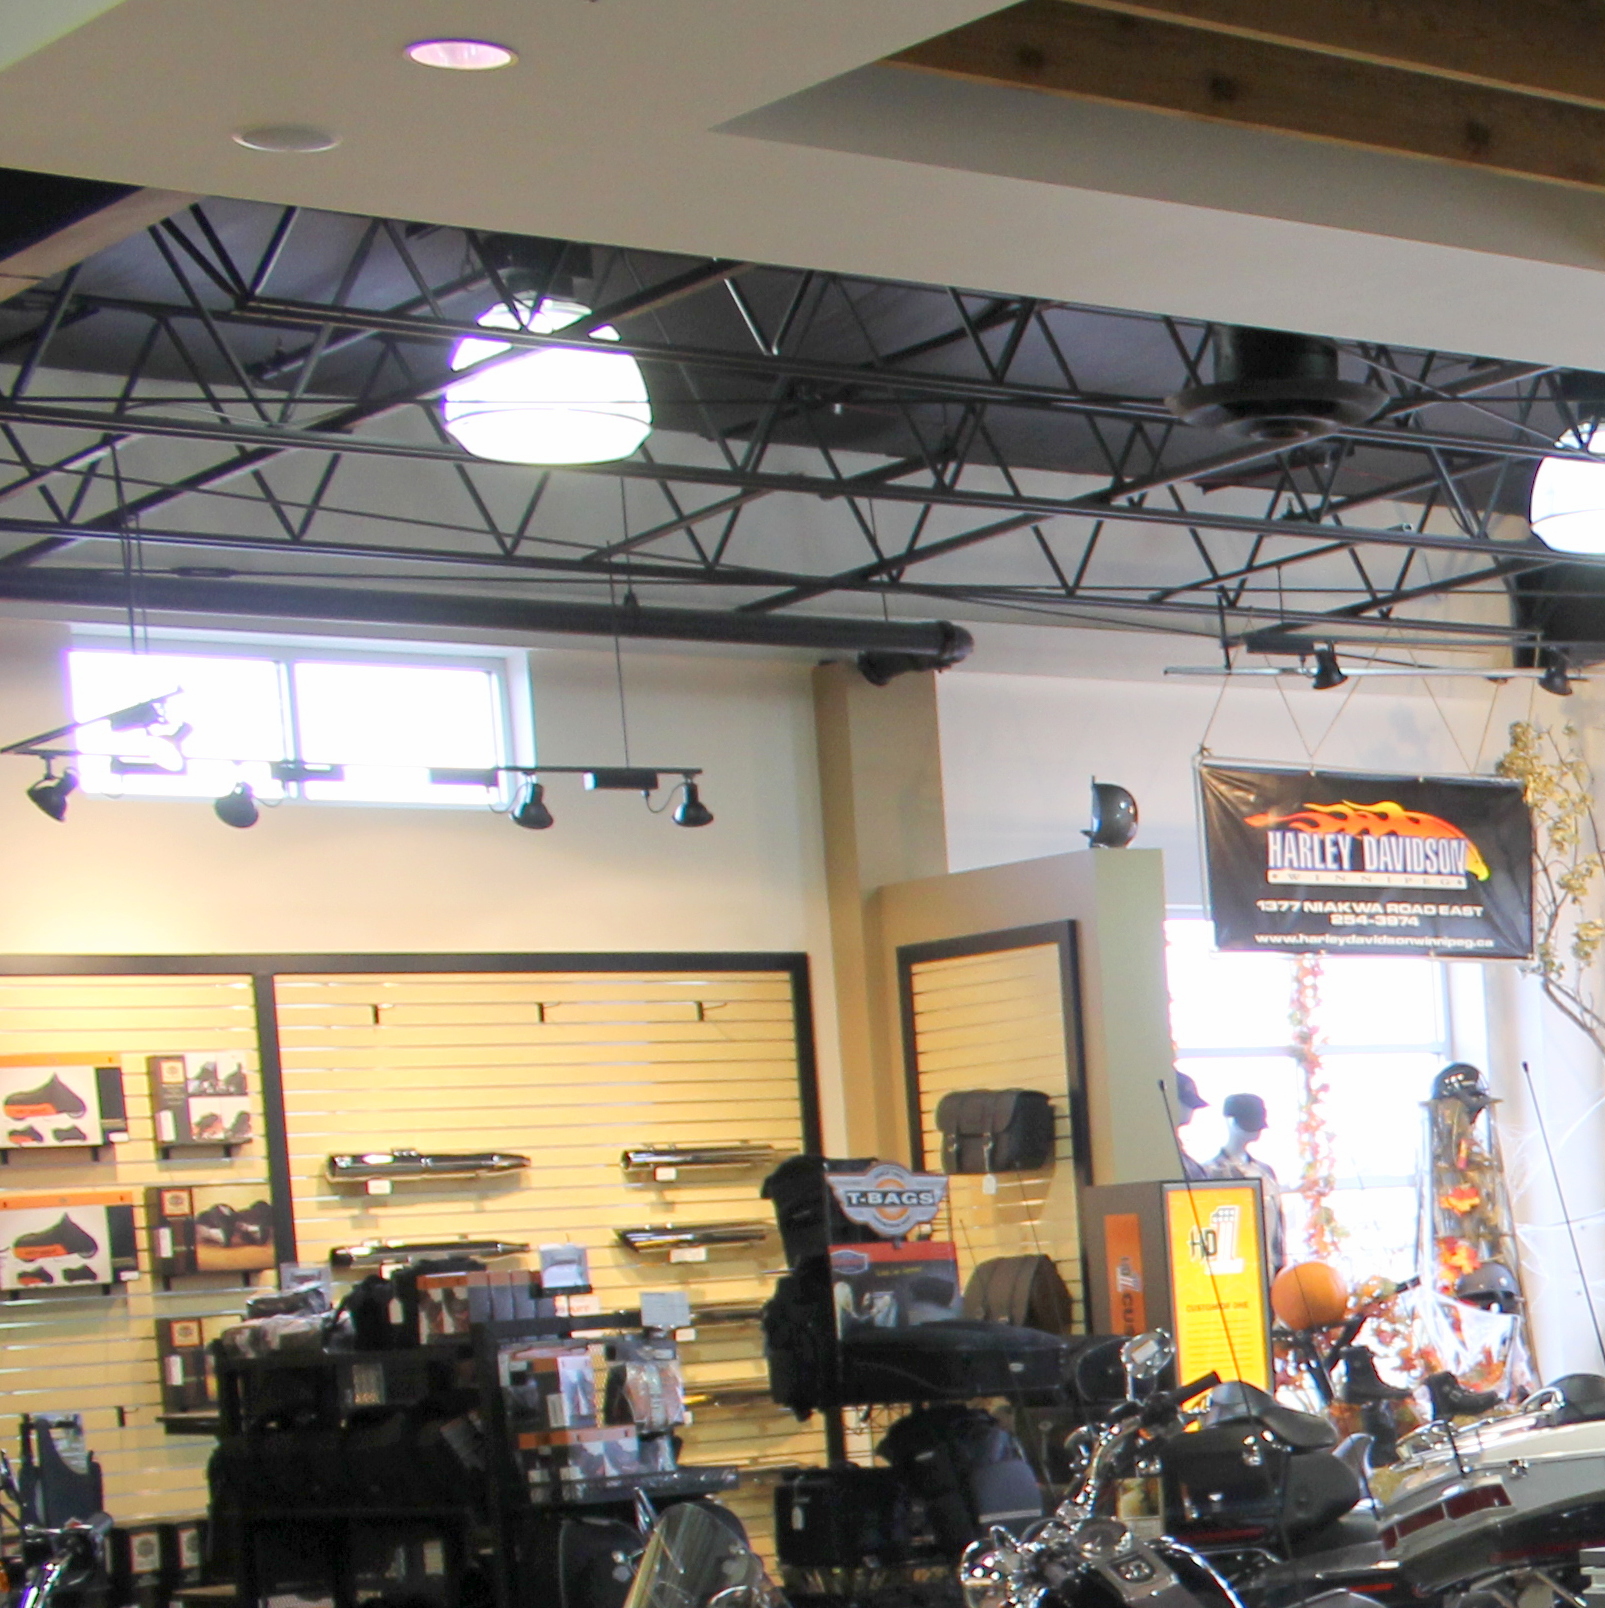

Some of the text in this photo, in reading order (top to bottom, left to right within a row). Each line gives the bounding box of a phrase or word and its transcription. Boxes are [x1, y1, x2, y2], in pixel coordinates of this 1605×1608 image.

[1268, 831, 1467, 874] HARLEY DAVIDSON
[1288, 873, 1451, 885] WINNIPEG
[1256, 900, 1484, 918] 1377 NIAKWA ROAD EAST
[1330, 913, 1420, 928] 254-3974
[1255, 933, 1494, 949] www.harleydavidsonwinnipeg.ca
[846, 1191, 935, 1205] T-BAGS
